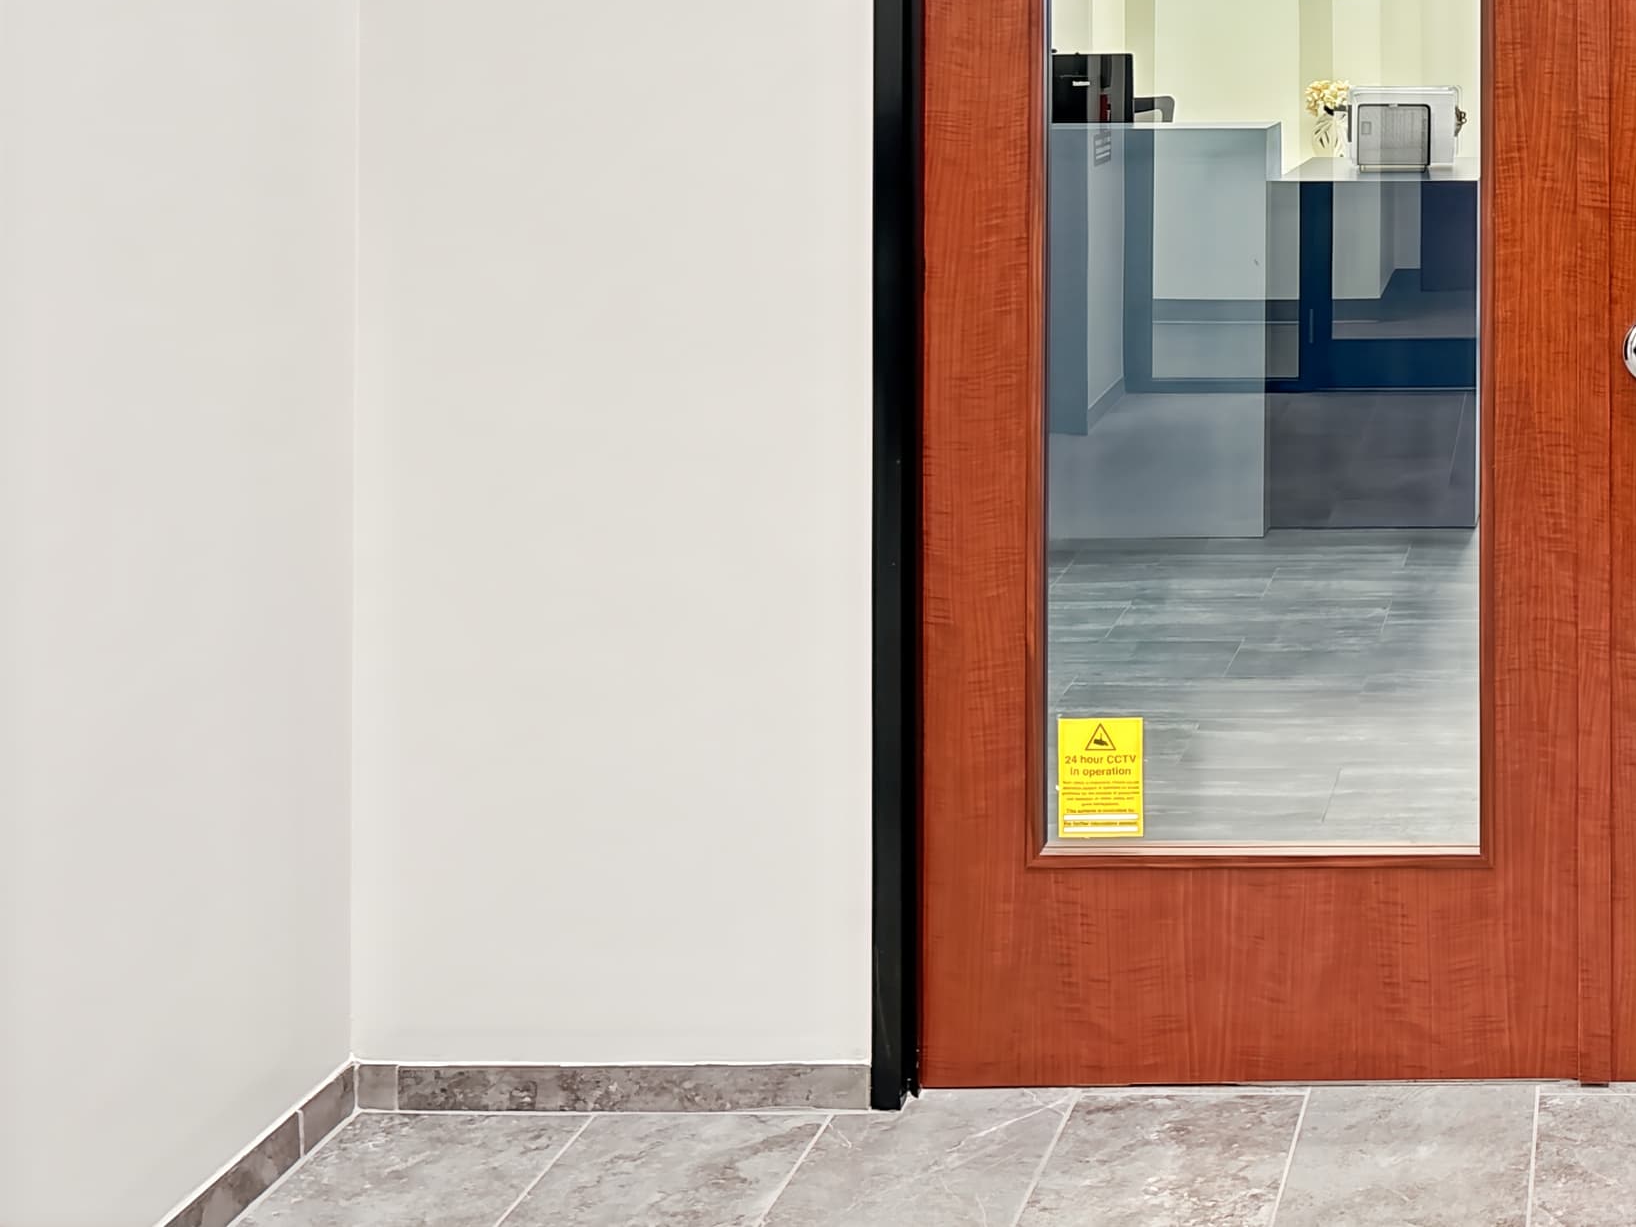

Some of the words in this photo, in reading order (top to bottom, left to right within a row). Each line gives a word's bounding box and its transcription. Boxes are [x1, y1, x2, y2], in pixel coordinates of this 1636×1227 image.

[1064, 755, 1077, 764] 24
[1079, 755, 1103, 764] hour
[1106, 754, 1137, 764] CCTV
[1082, 766, 1131, 777] operation
